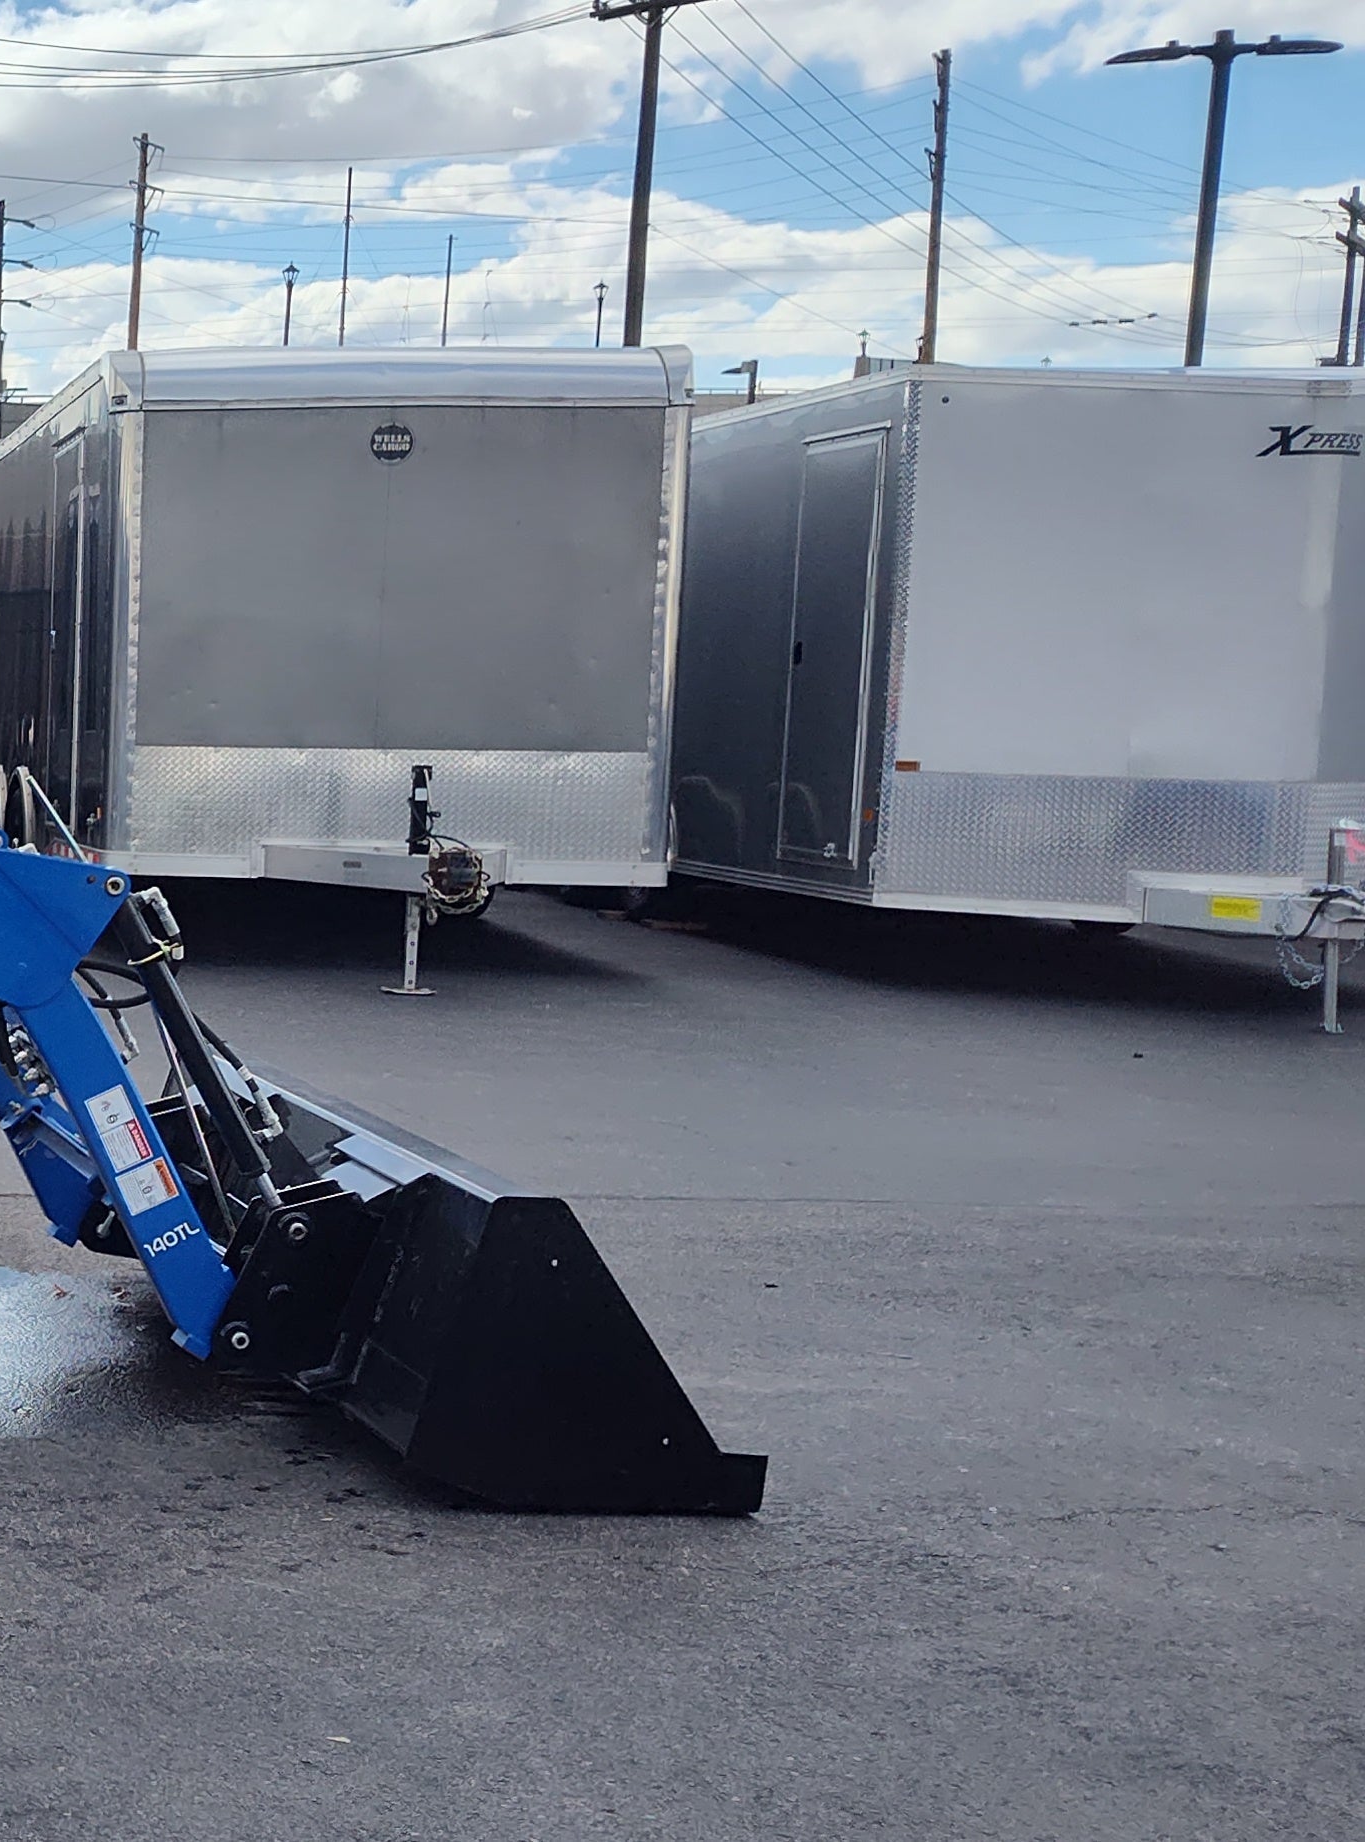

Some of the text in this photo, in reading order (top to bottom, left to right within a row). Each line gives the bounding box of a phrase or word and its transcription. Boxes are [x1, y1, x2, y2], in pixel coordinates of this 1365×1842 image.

[372, 442, 410, 452] CARGO
[374, 434, 411, 443] WELLS
[1255, 424, 1363, 457] XPRESS
[144, 1222, 200, 1258] 140TL
